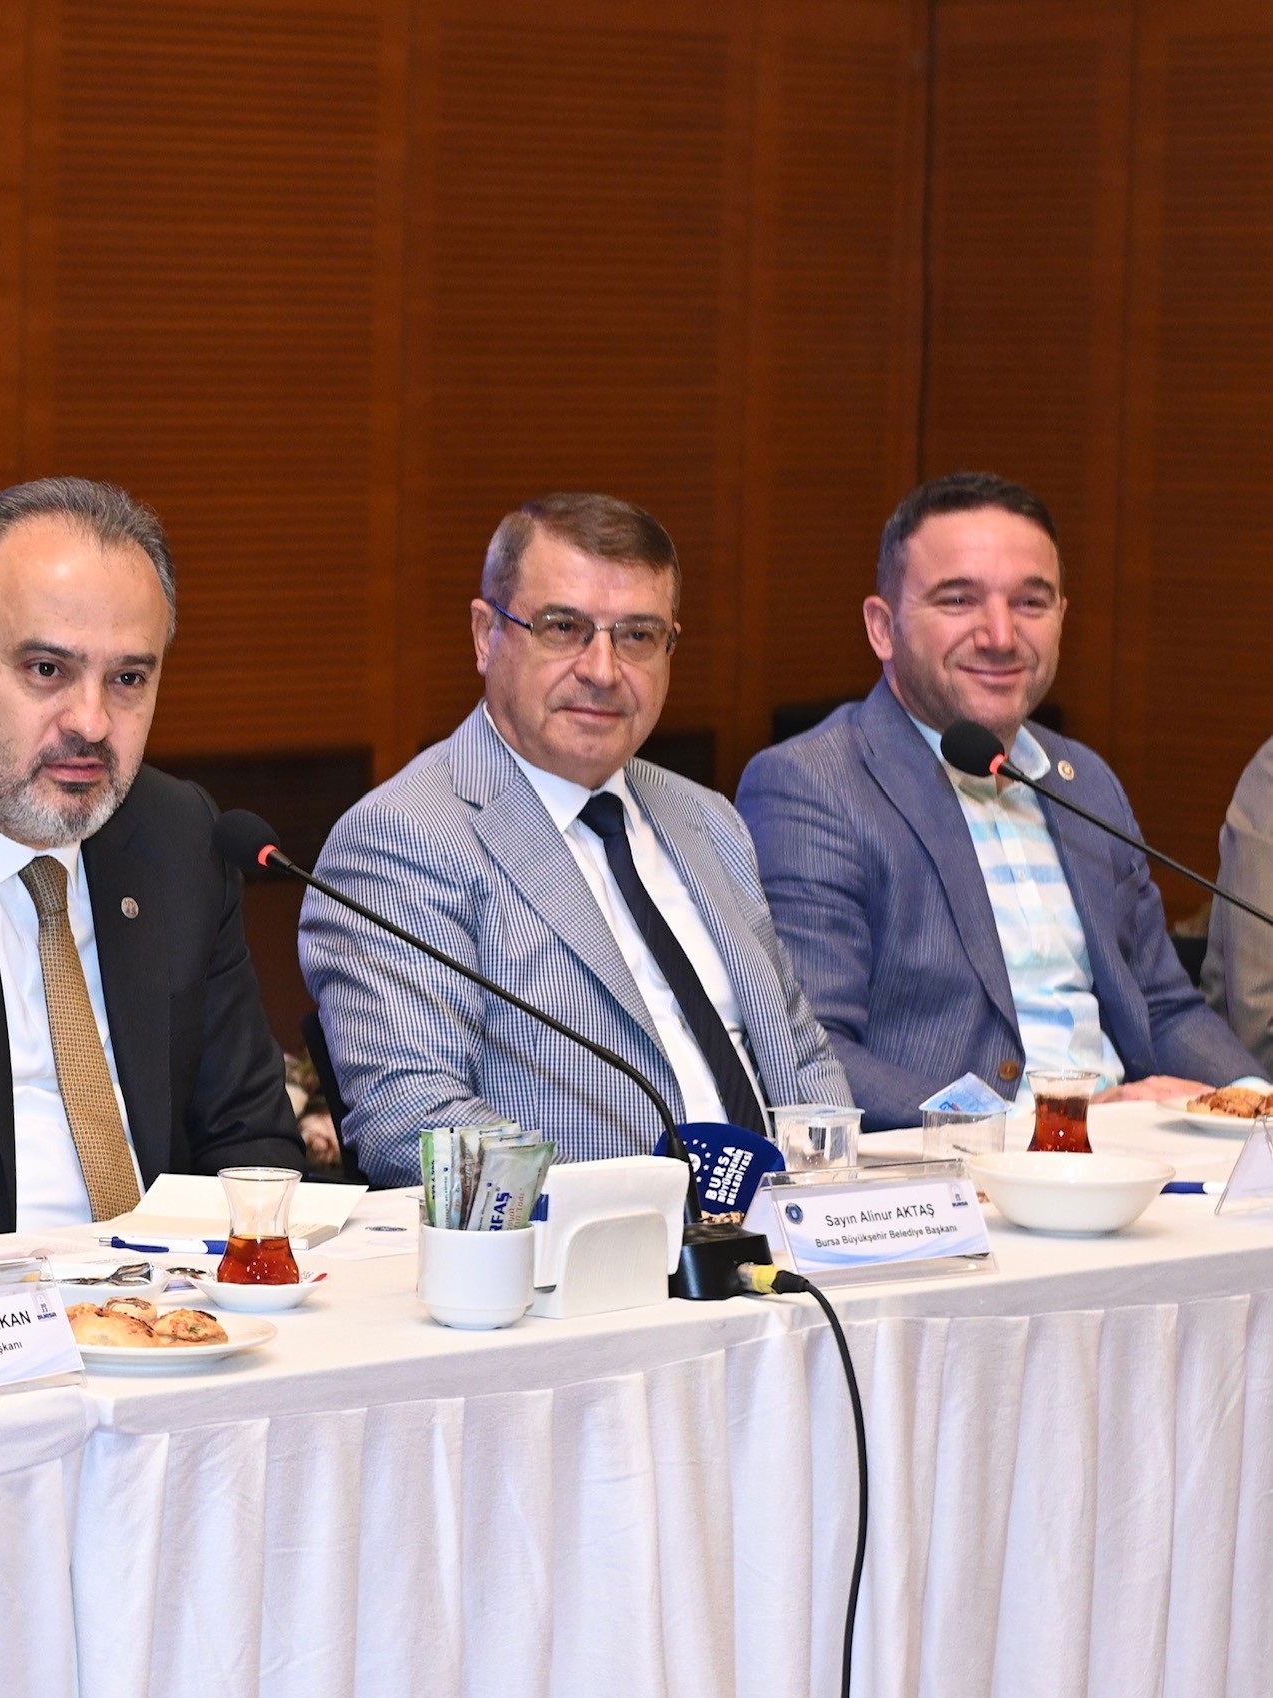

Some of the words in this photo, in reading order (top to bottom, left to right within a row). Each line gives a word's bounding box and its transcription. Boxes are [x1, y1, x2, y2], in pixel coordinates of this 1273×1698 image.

[705, 1146, 736, 1201] BURSA
[717, 1148, 744, 1203] BÜYÜKŞEHİR
[726, 1151, 754, 1206] BELEDİYESİ
[489, 1192, 513, 1231] RFAŞ
[825, 1214, 858, 1228] Sayın
[861, 1210, 892, 1222] Alinur
[897, 1203, 935, 1218] AKTAŞ
[815, 1238, 841, 1248] Bursa
[842, 1232, 887, 1245] Büyükşehir
[889, 1228, 924, 1238] Belediye
[925, 1224, 958, 1235] Başkanı
